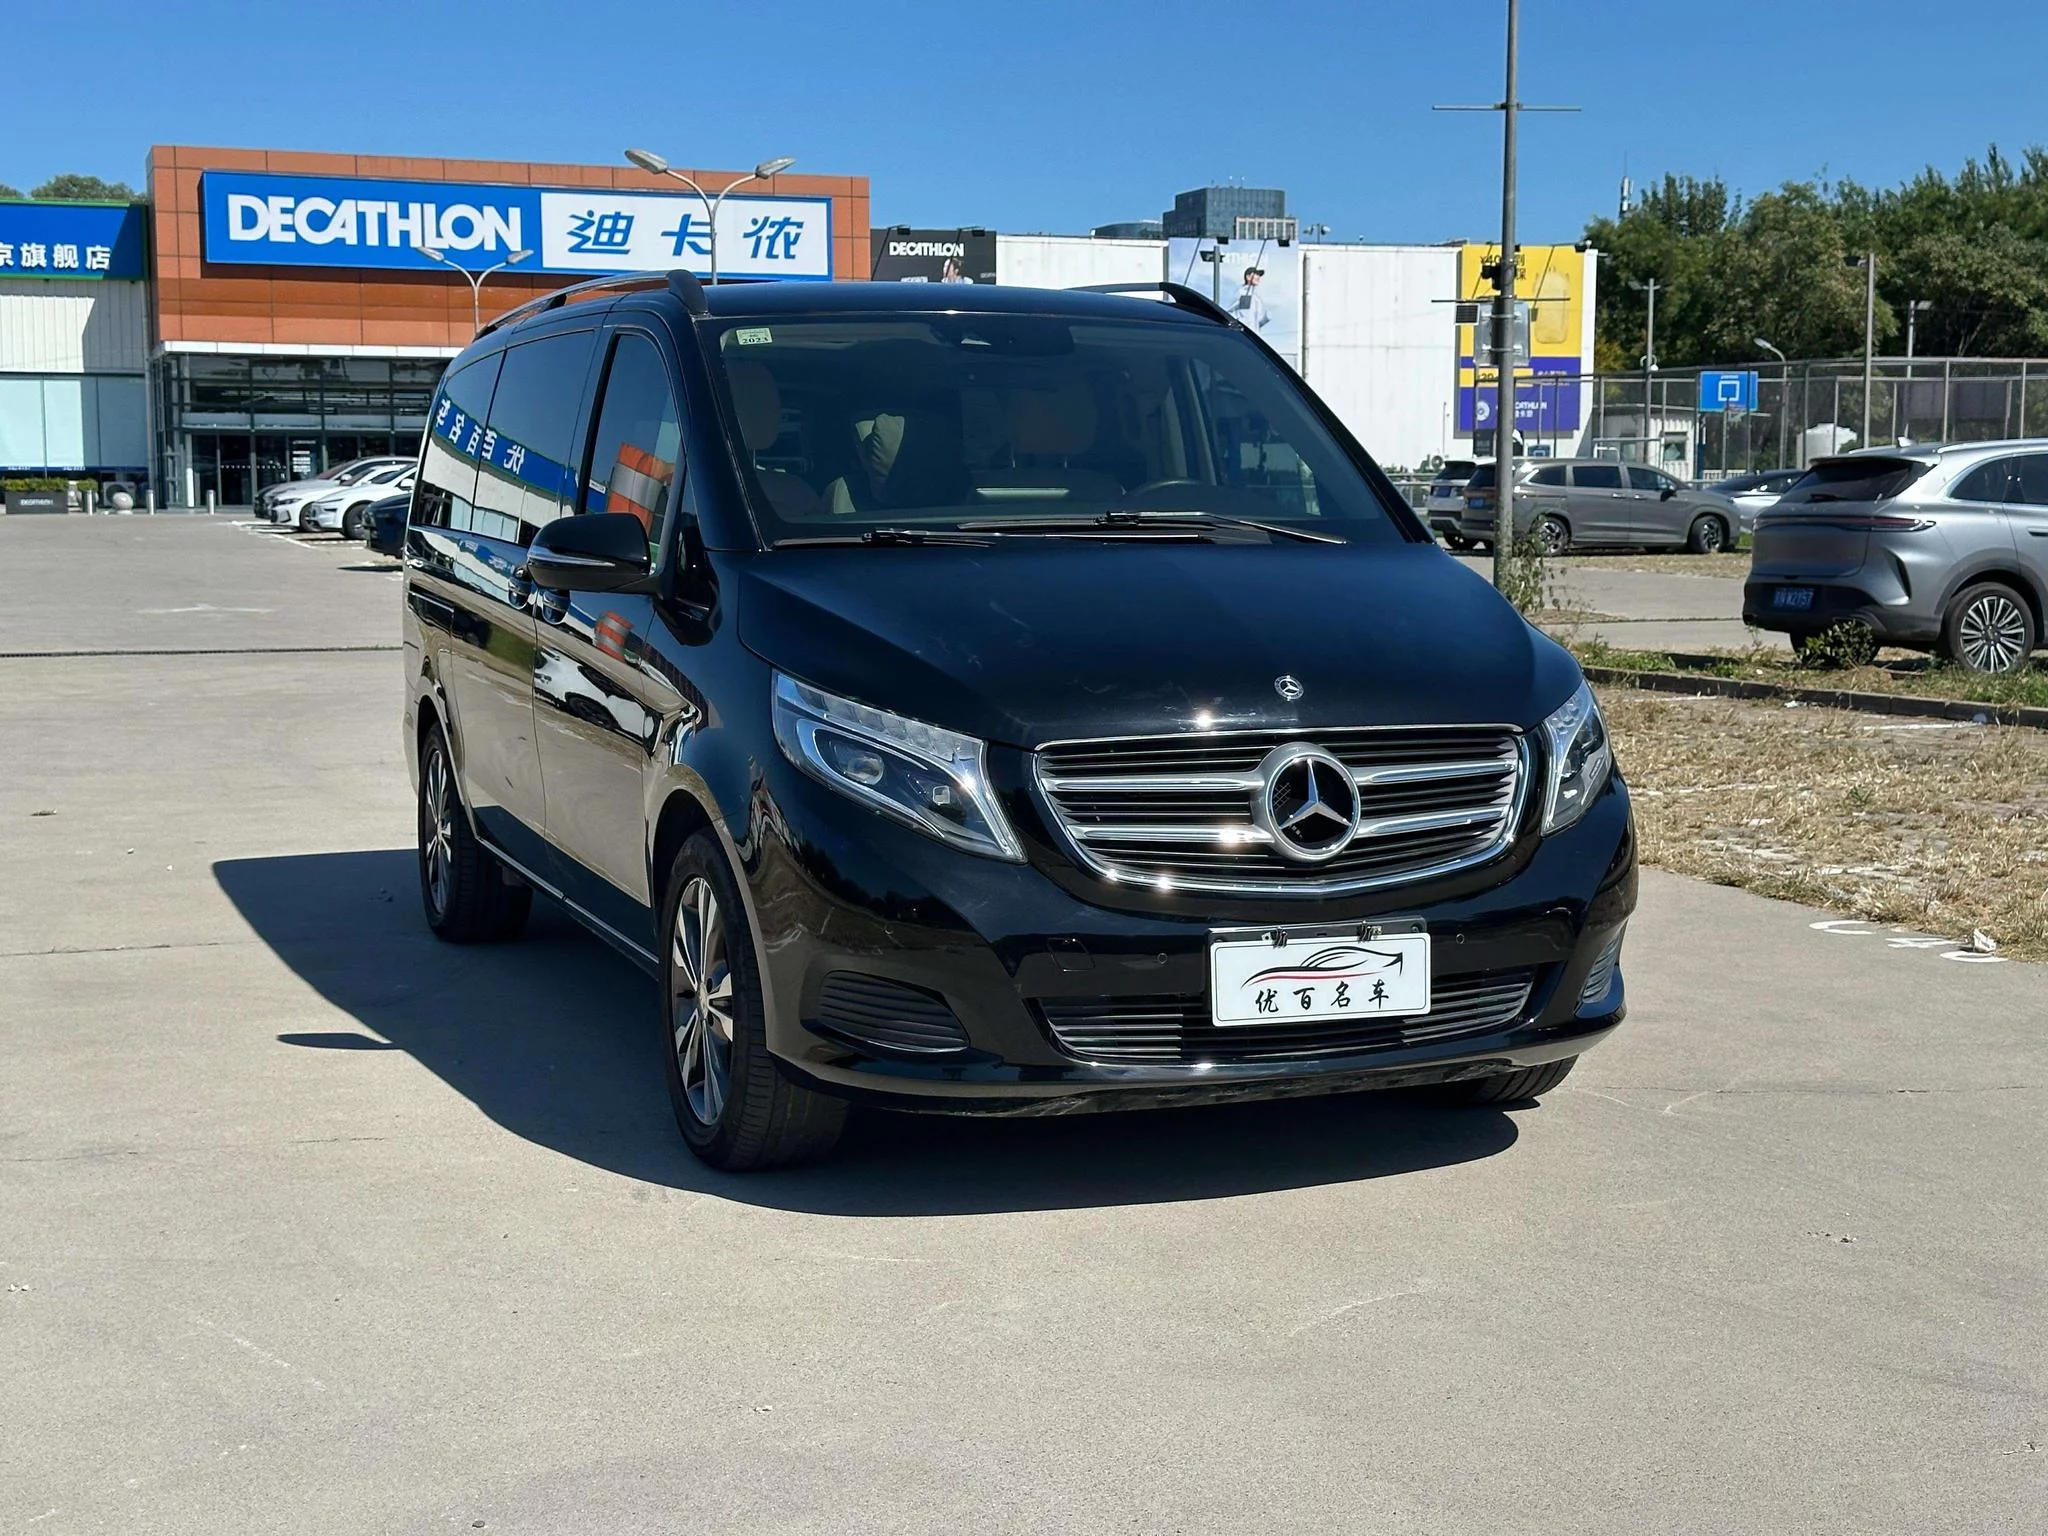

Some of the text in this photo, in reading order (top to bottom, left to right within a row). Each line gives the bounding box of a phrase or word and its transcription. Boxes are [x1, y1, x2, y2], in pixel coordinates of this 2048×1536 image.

[227, 193, 522, 252] DECATHLON
[567, 209, 805, 260] 迪卡侬
[889, 242, 964, 256] DECATHLON
[1254, 978, 1390, 1014] 优百名车
